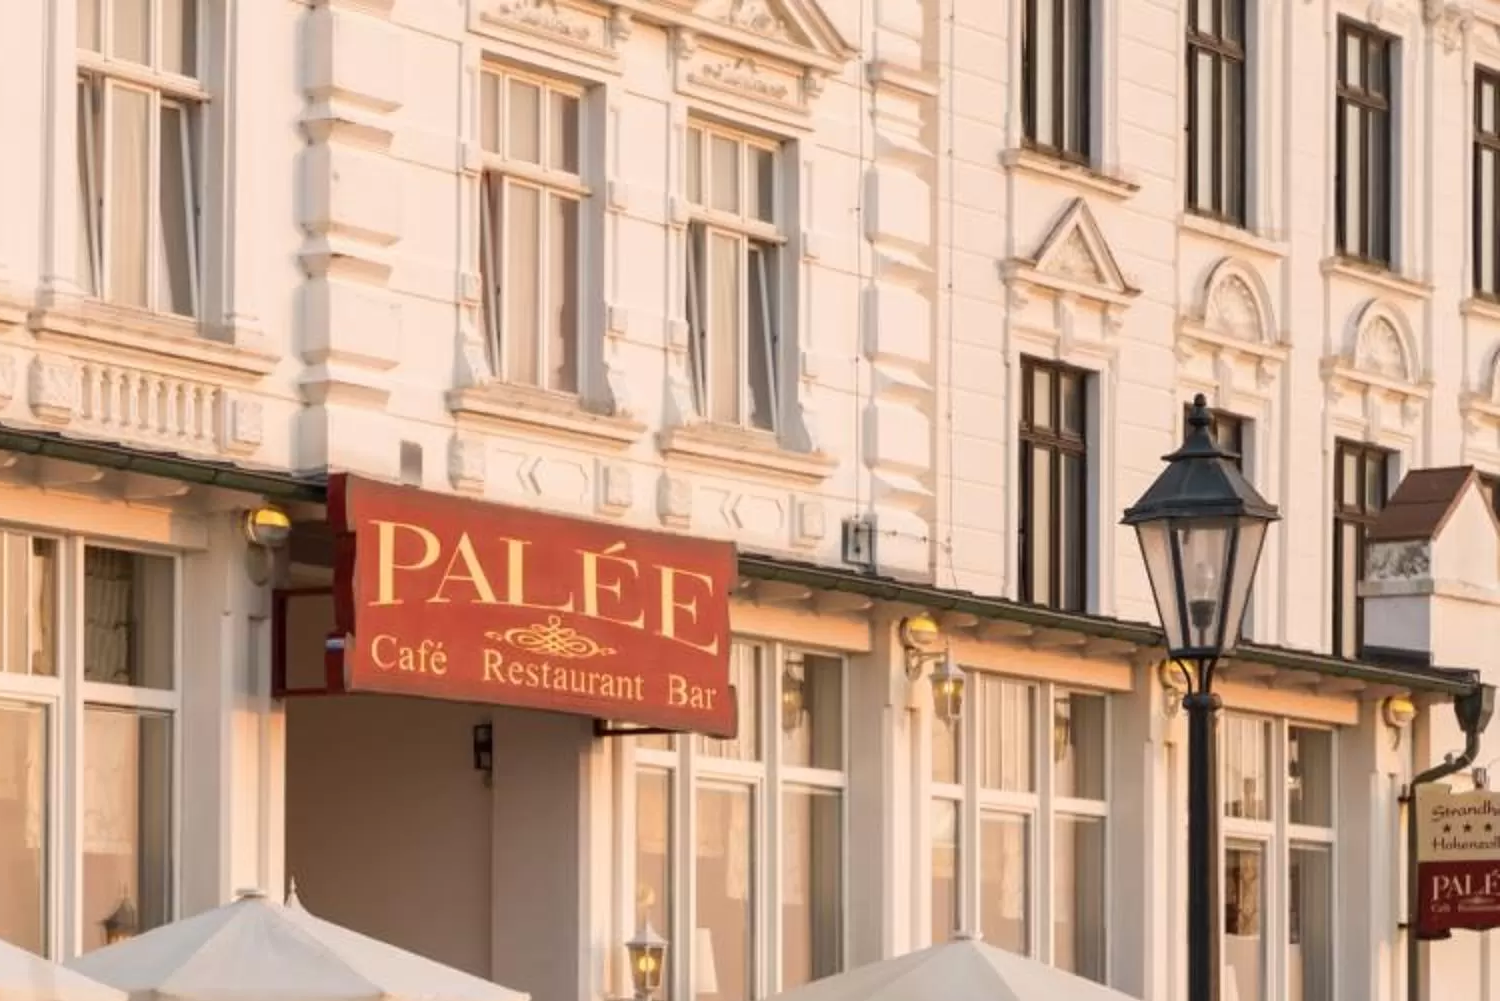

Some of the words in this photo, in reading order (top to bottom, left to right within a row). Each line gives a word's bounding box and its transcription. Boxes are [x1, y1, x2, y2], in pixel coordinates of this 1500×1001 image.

[368, 519, 719, 657] PALÉE
[370, 634, 448, 676] Café
[481, 648, 645, 702] Restaurant
[667, 673, 717, 711] Bar
